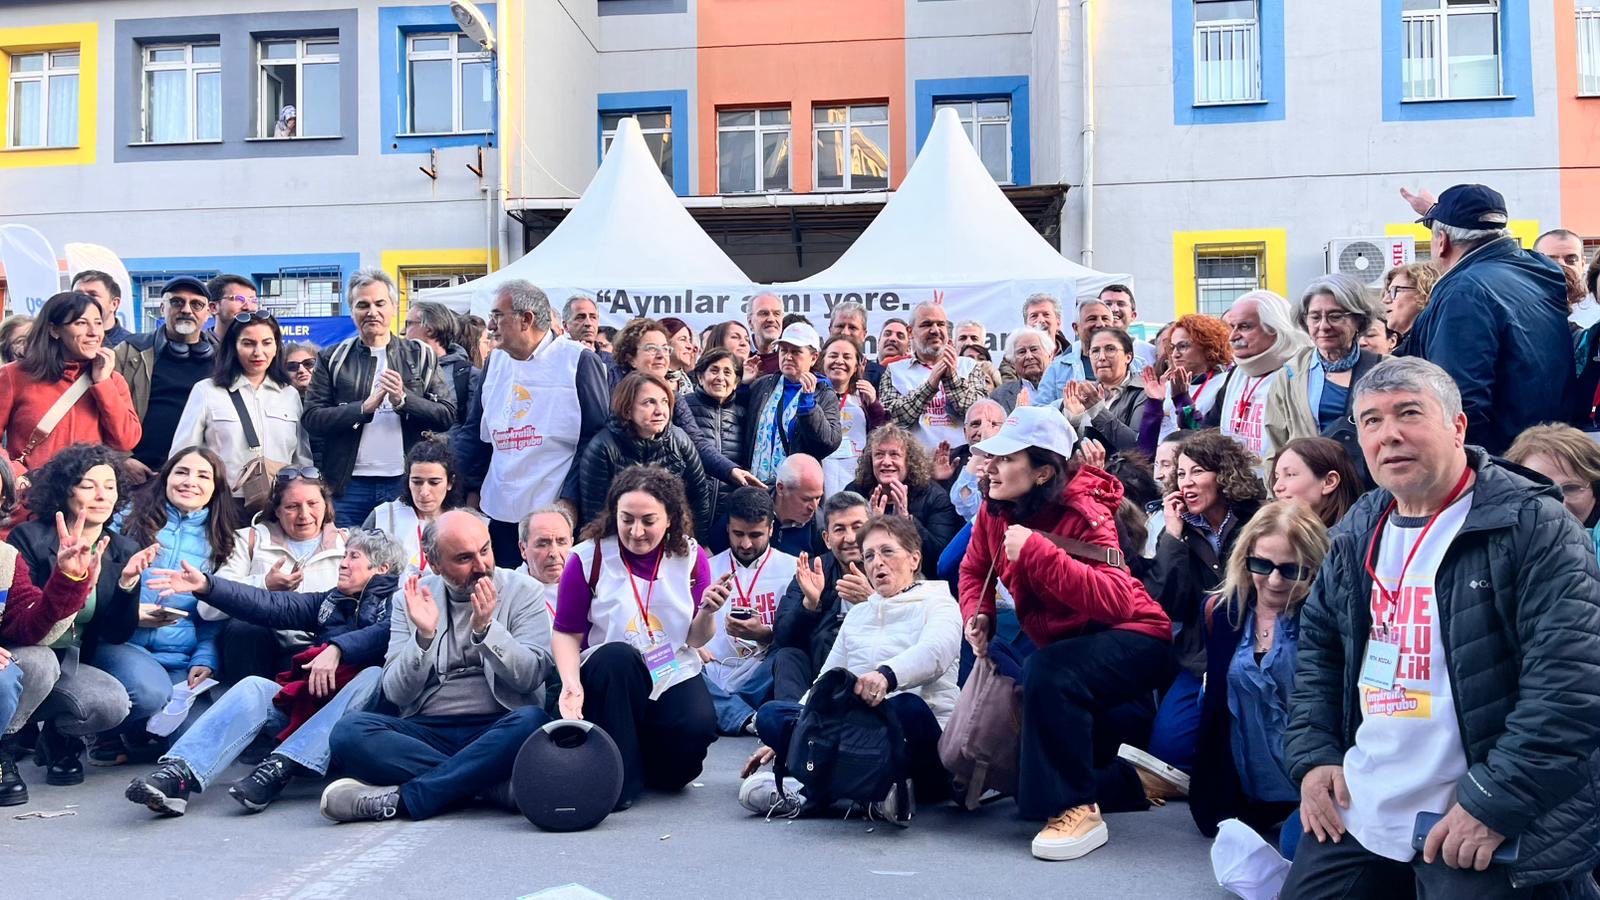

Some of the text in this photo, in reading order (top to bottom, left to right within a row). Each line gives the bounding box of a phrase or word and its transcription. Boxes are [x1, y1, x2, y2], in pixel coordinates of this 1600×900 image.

[1392, 241, 1403, 266] STEL
[279, 325, 310, 336] MLER
[1396, 586, 1432, 624] VE
[1395, 655, 1431, 681] LiK
